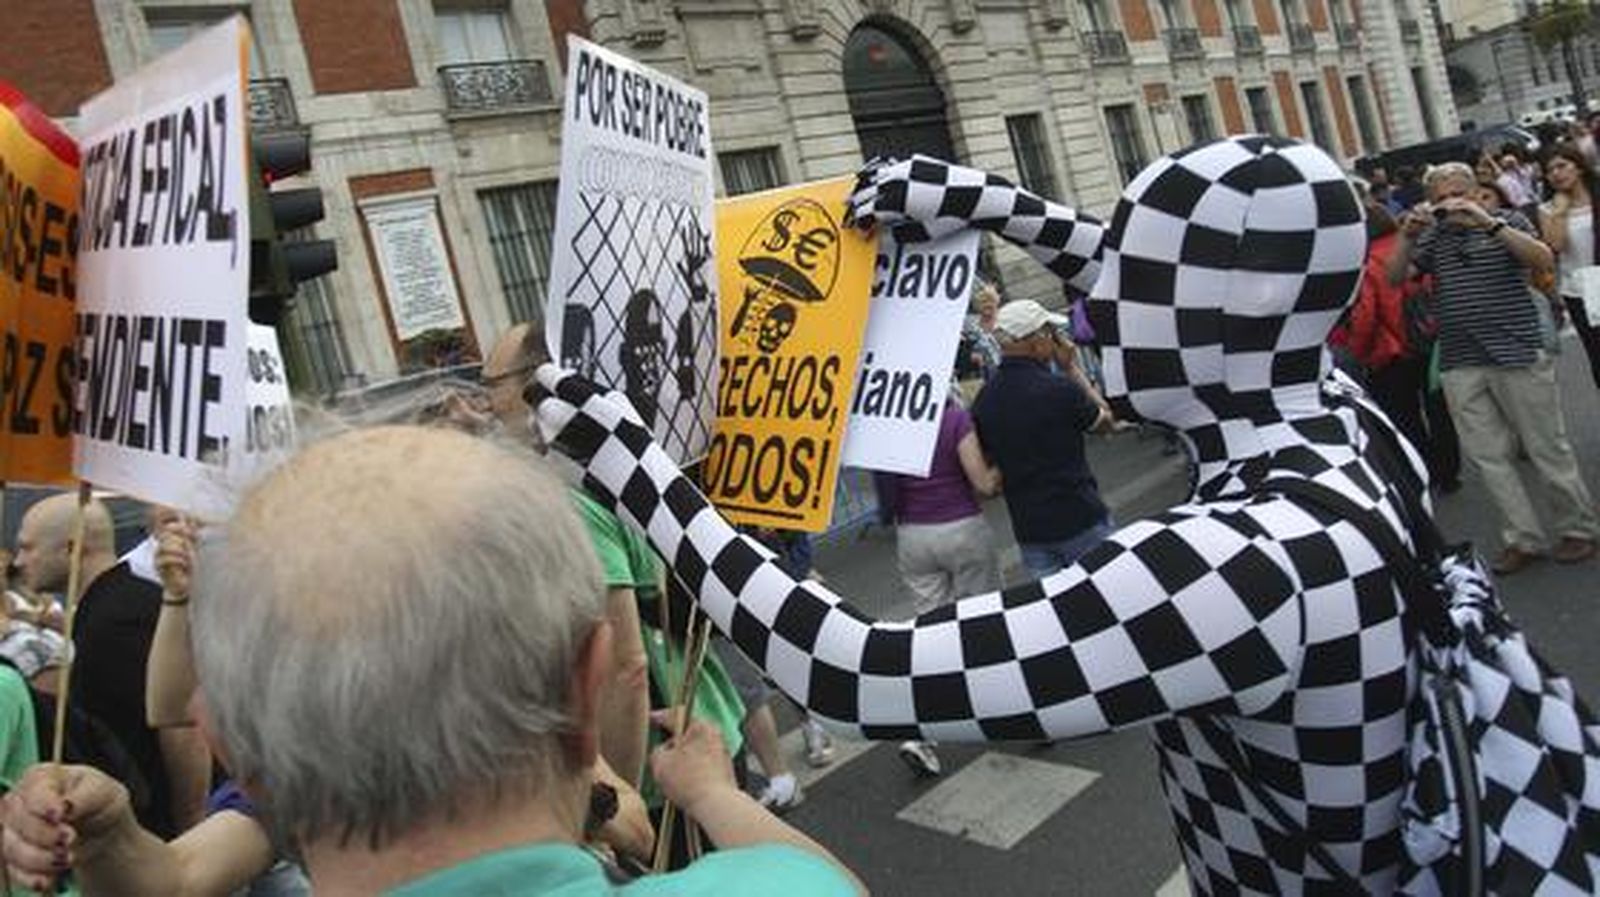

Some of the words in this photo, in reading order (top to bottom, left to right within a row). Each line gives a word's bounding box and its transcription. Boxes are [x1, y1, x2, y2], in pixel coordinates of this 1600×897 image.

[574, 50, 617, 131] POR
[621, 70, 652, 142] SER
[654, 84, 707, 160] POBRE
[852, 352, 937, 421] iano.
